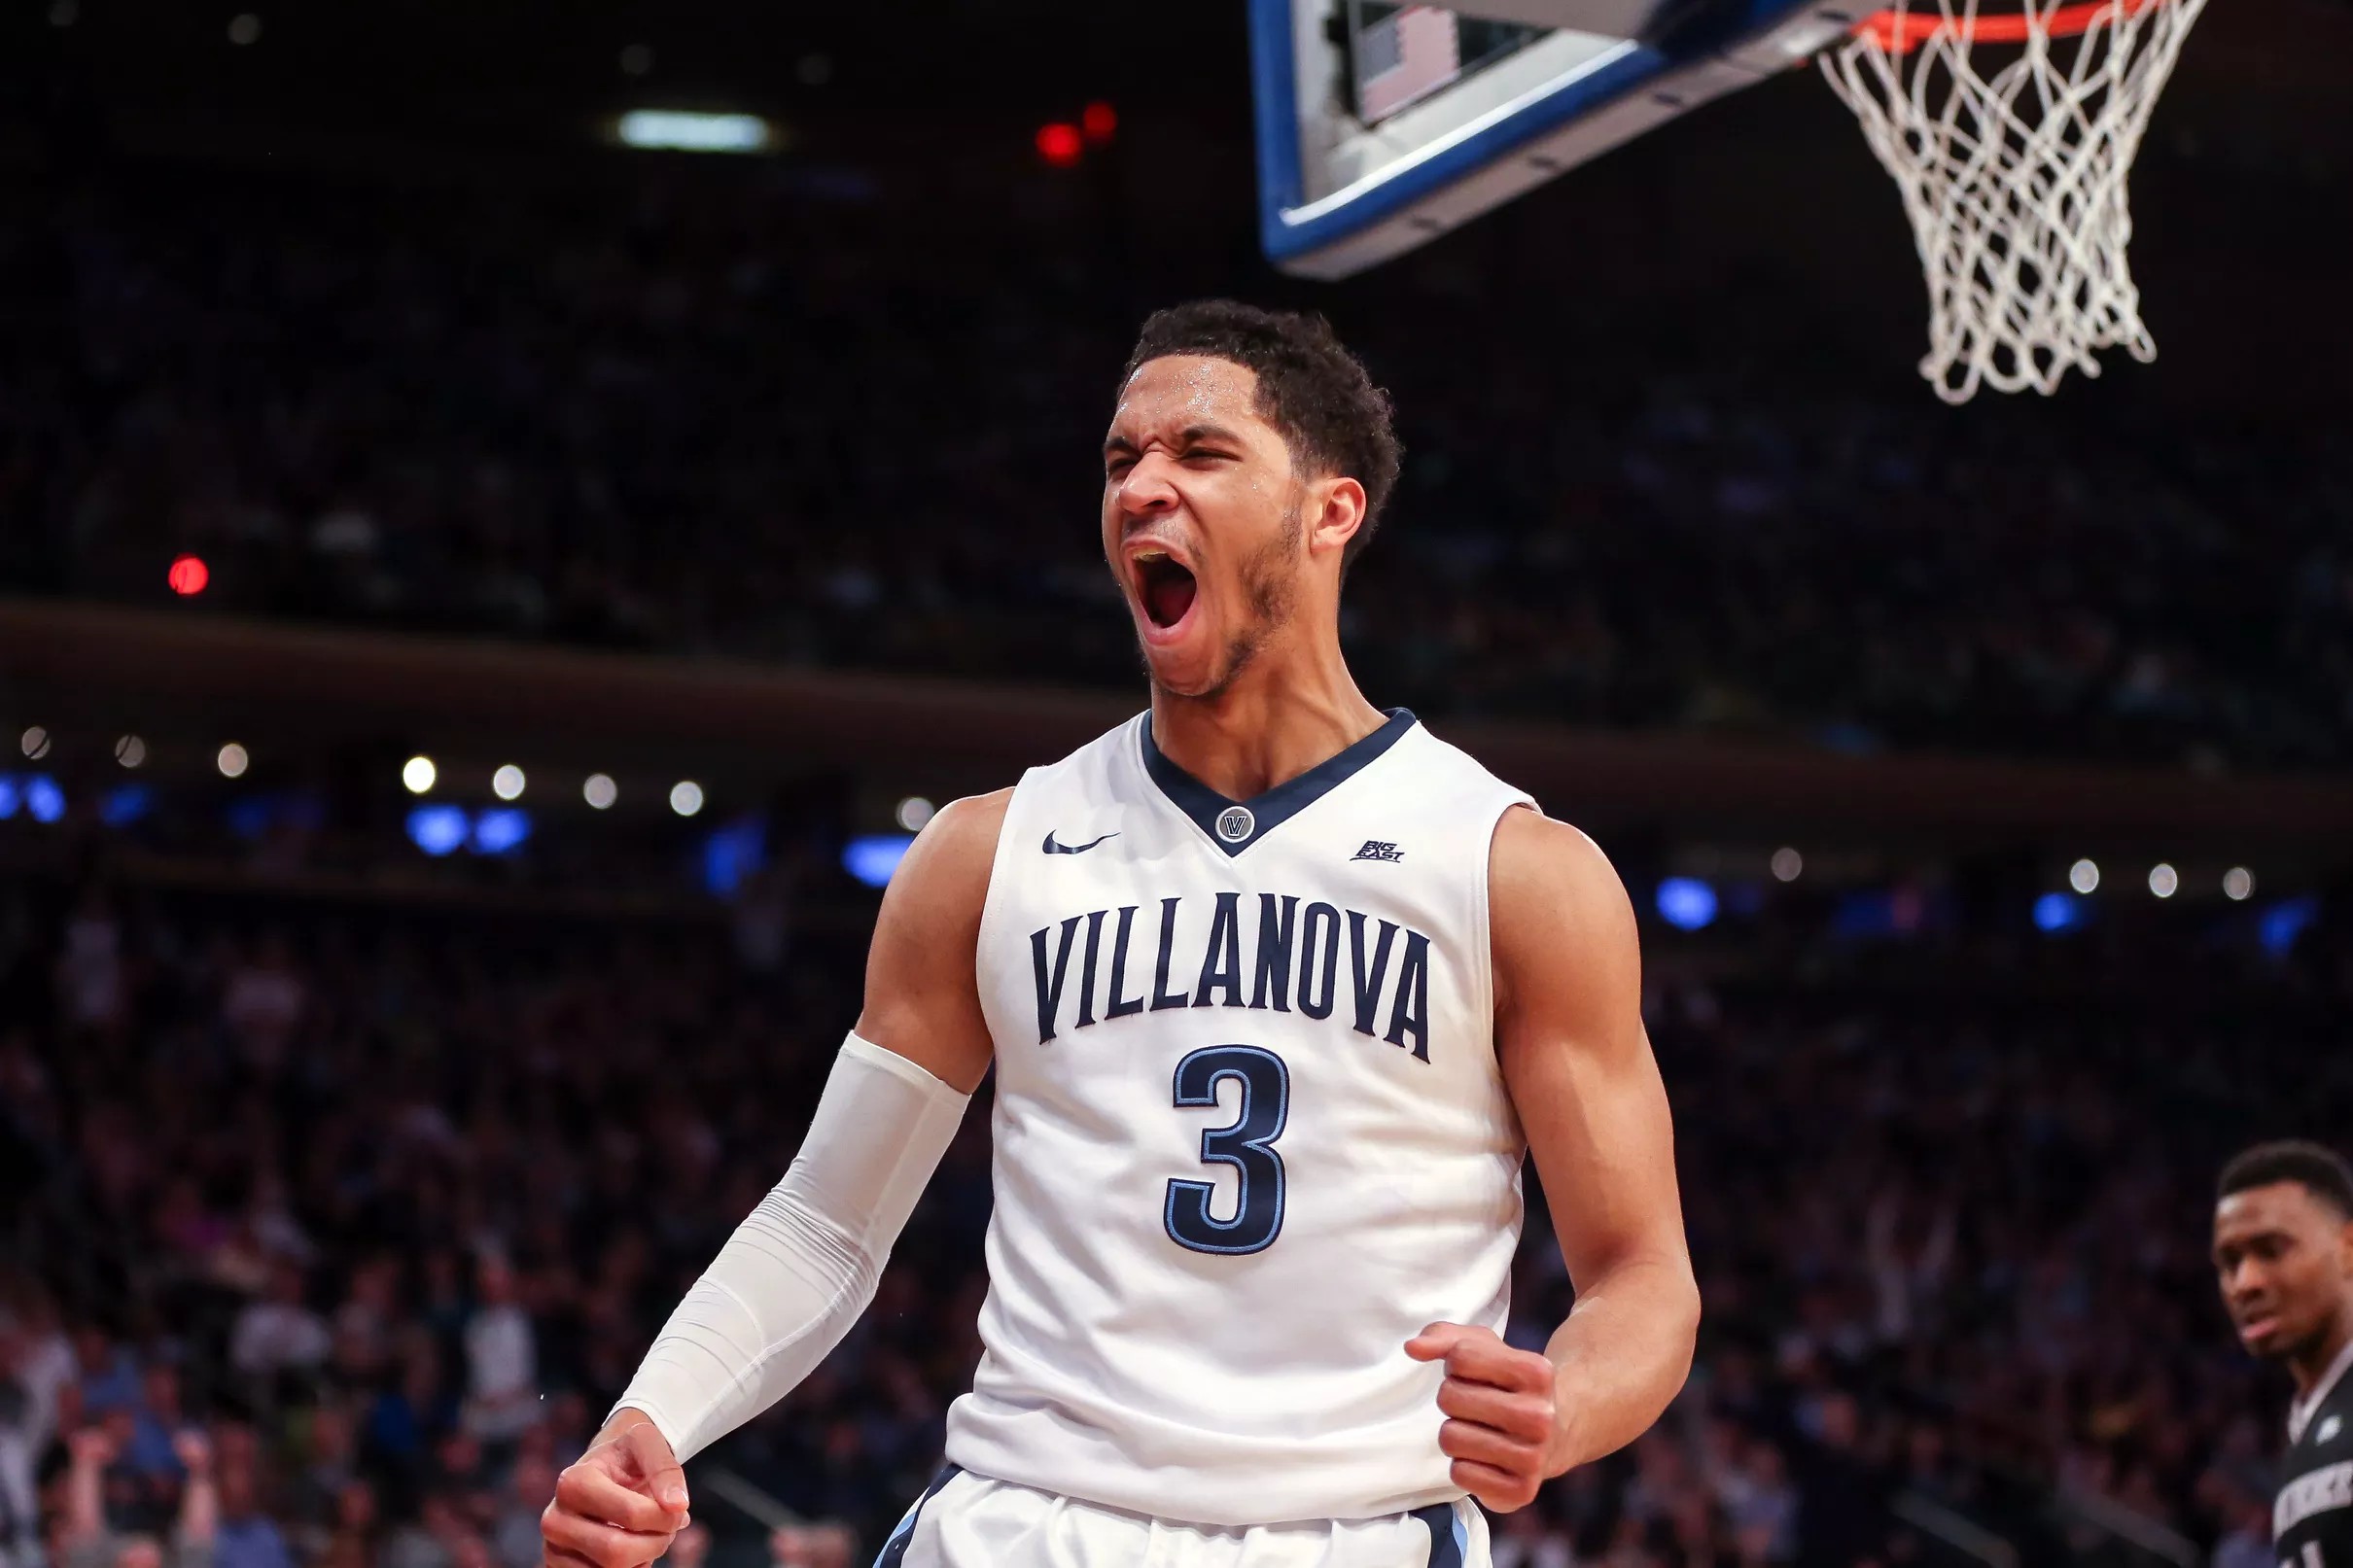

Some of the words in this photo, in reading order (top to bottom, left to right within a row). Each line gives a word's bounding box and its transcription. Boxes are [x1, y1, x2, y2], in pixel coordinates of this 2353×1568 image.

[1224, 816, 1247, 837] V
[1355, 849, 1405, 860] EAST
[1361, 840, 1397, 852] BIG
[1030, 892, 1431, 1064] VILLANOVA
[1163, 1044, 1290, 1256] 3
